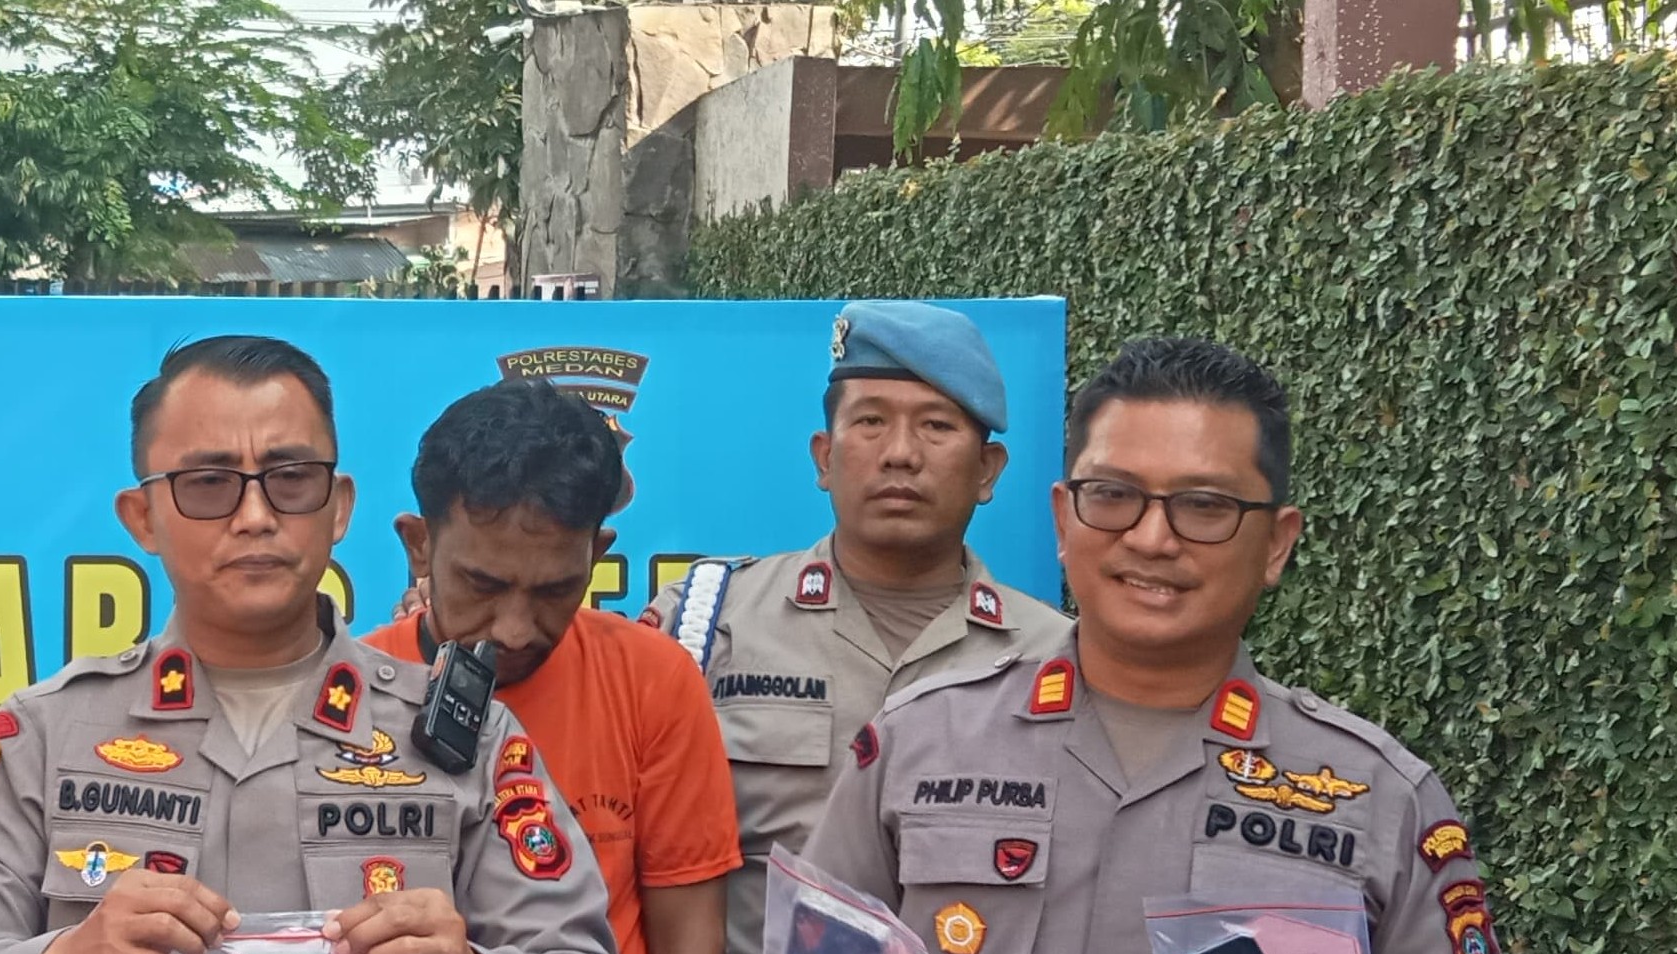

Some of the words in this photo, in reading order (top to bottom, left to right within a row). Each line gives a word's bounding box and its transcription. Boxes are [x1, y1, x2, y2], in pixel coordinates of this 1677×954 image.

[506, 350, 639, 370] POLRESTABES
[521, 362, 625, 378] MEDAN
[586, 391, 629, 407] UTARA
[58, 778, 202, 827] B.GUNANTI
[912, 778, 975, 806] PHILIP
[975, 779, 1047, 809] PURBA
[317, 802, 436, 838] POLRI
[1204, 803, 1356, 868] POLRI
